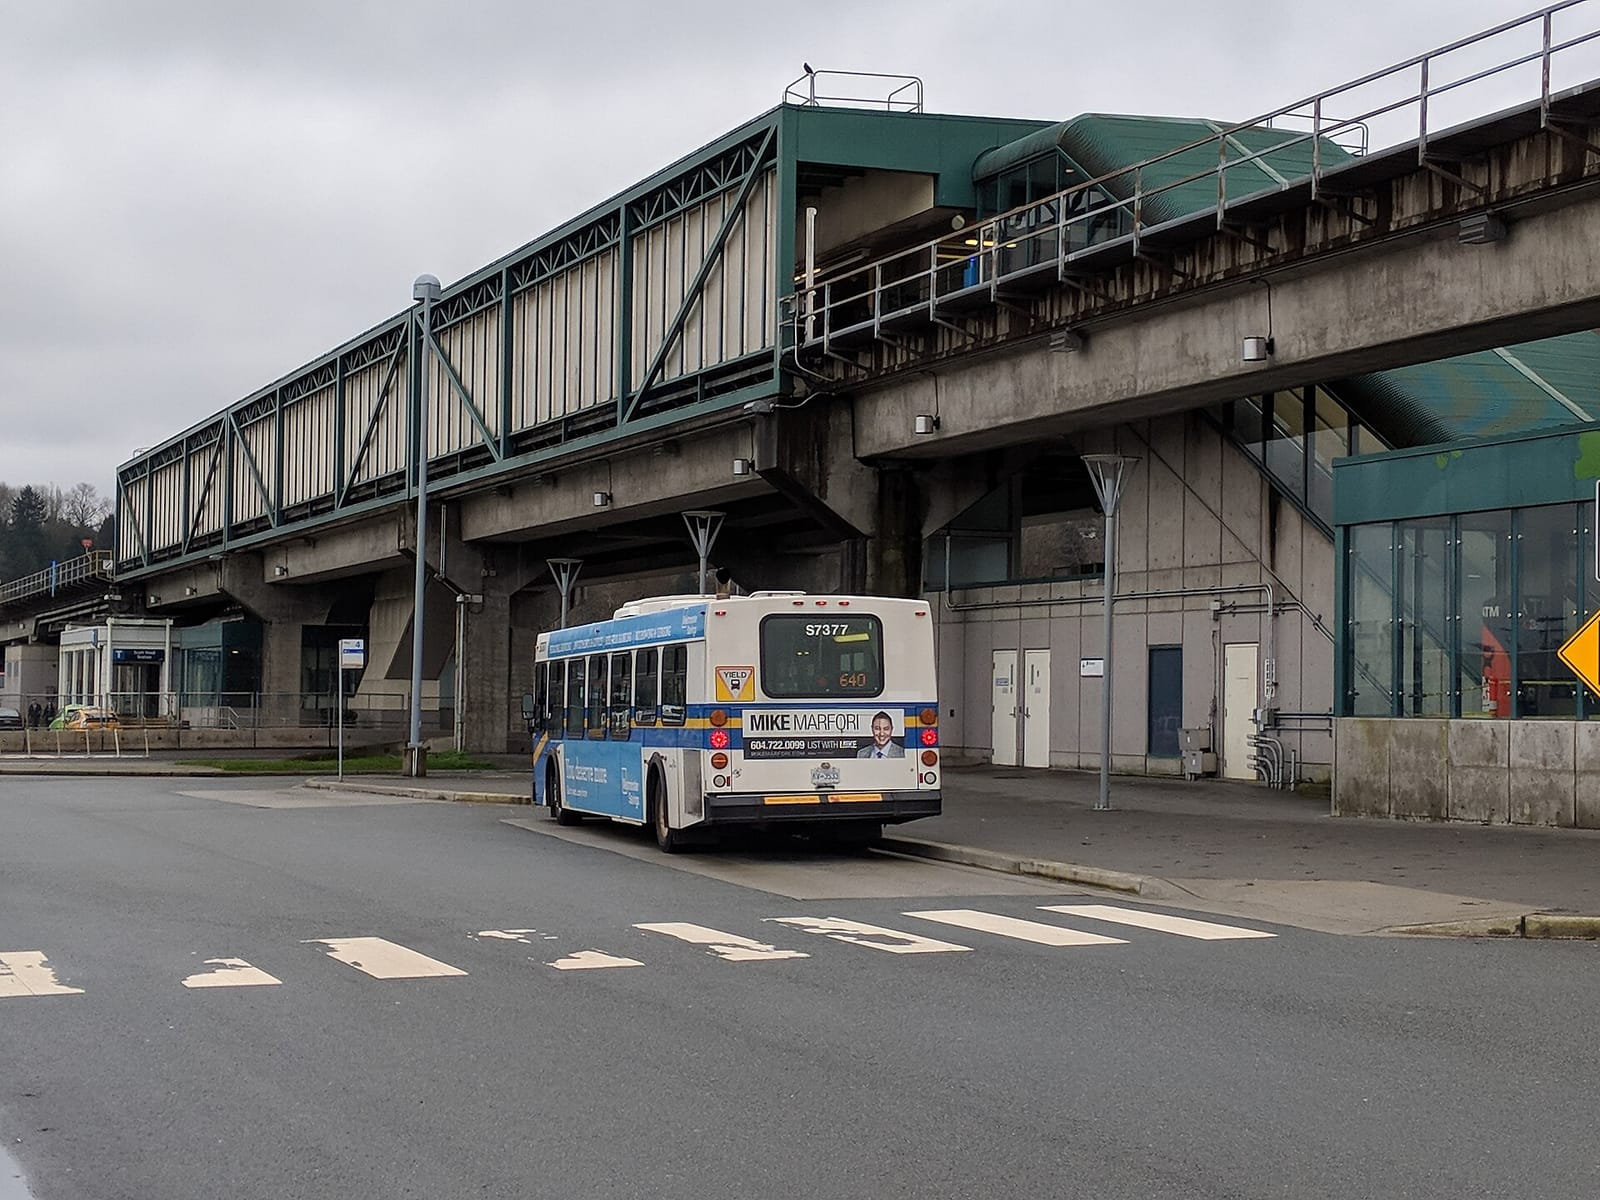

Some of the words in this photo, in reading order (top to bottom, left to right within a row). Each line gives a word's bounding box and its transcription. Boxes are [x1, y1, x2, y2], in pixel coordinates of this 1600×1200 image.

[805, 624, 849, 636] S7377
[839, 673, 866, 687] 640
[750, 714, 790, 731] MIKE
[750, 740, 806, 750] 604.722.0099
[807, 740, 821, 749] LIST
[821, 740, 839, 749] WITH
